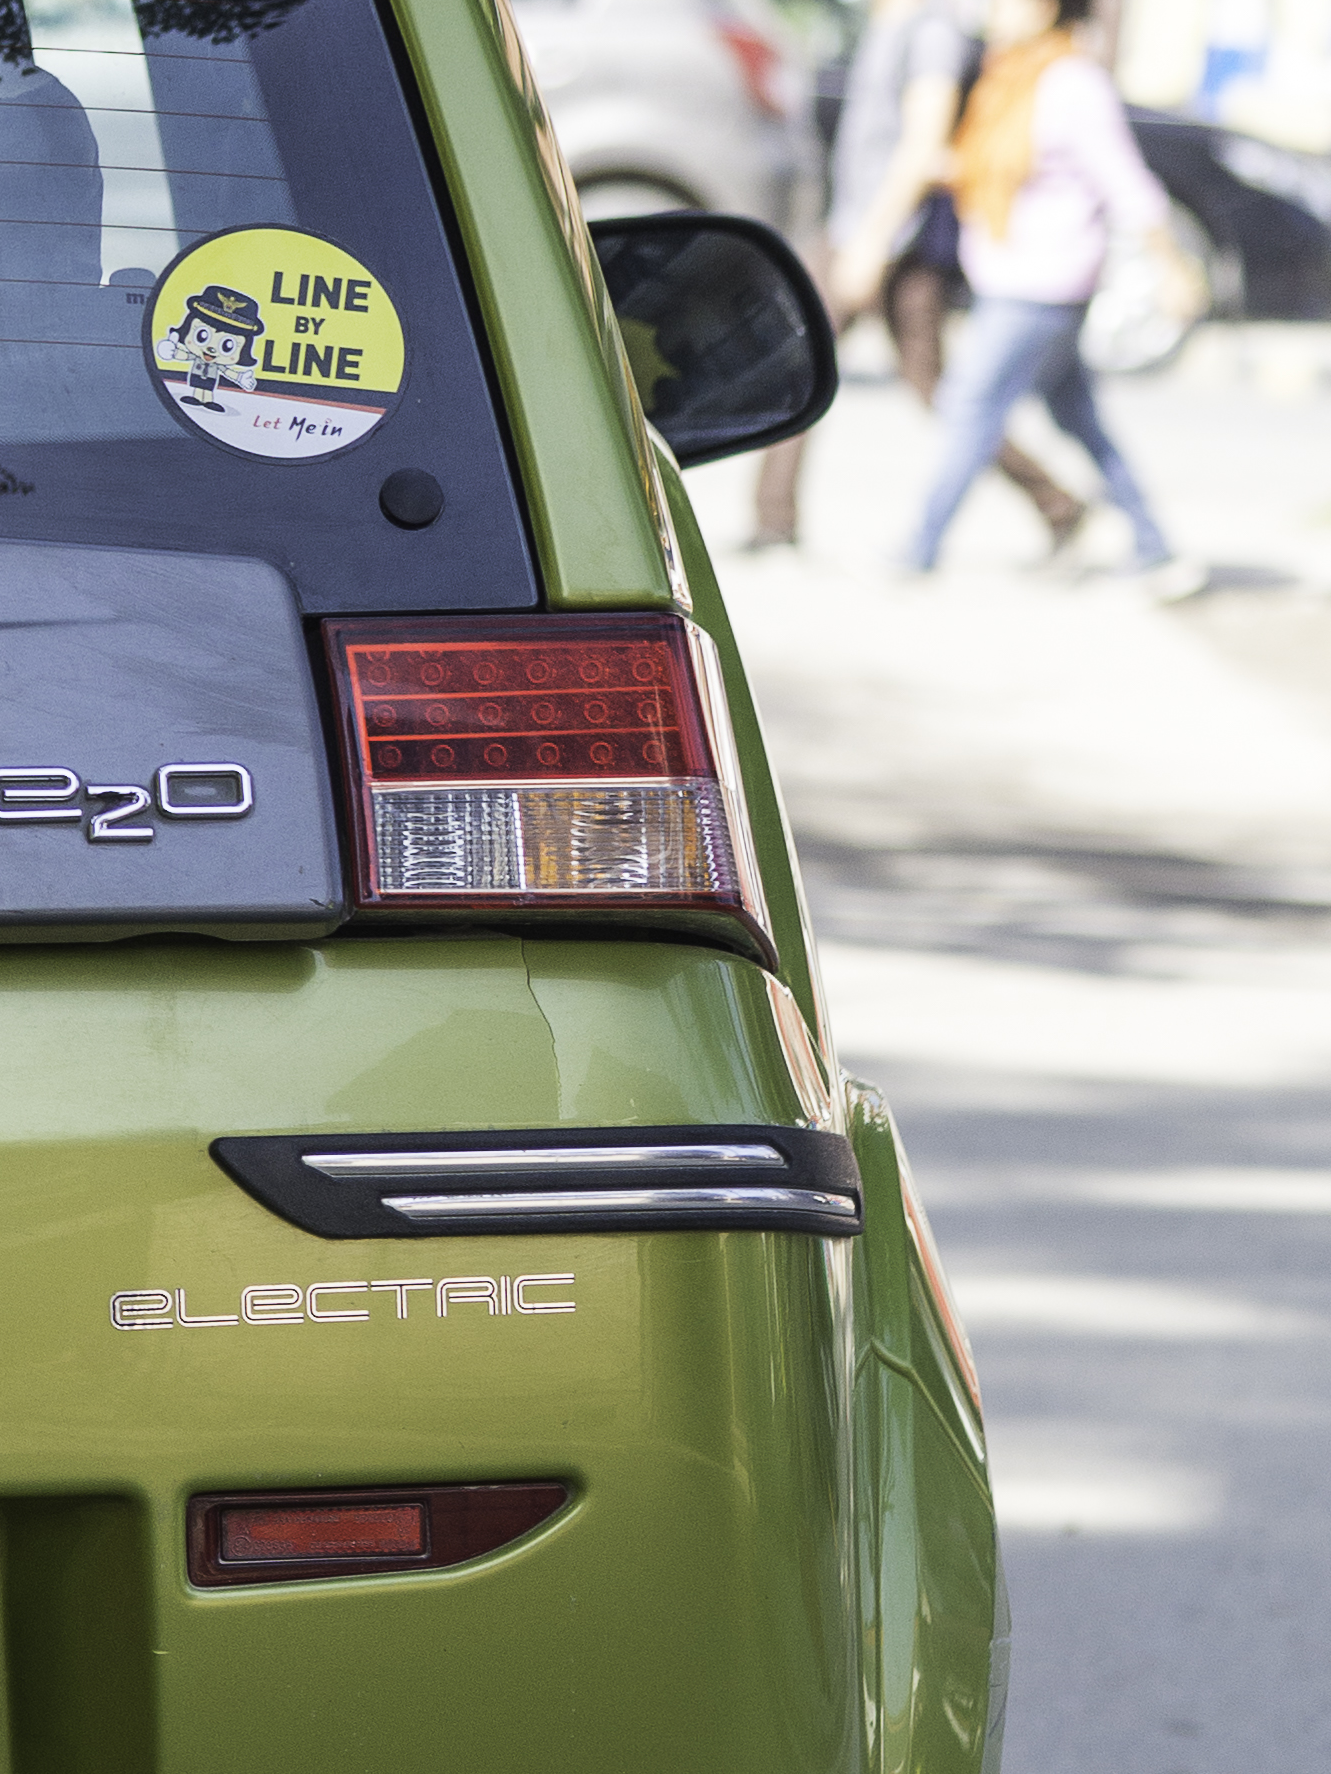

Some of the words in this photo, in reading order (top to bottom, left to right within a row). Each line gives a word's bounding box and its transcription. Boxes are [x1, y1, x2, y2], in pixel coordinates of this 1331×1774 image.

[270, 271, 372, 313] LINE
[294, 316, 326, 335] BY
[261, 339, 364, 381] LINE
[253, 415, 282, 430] Let
